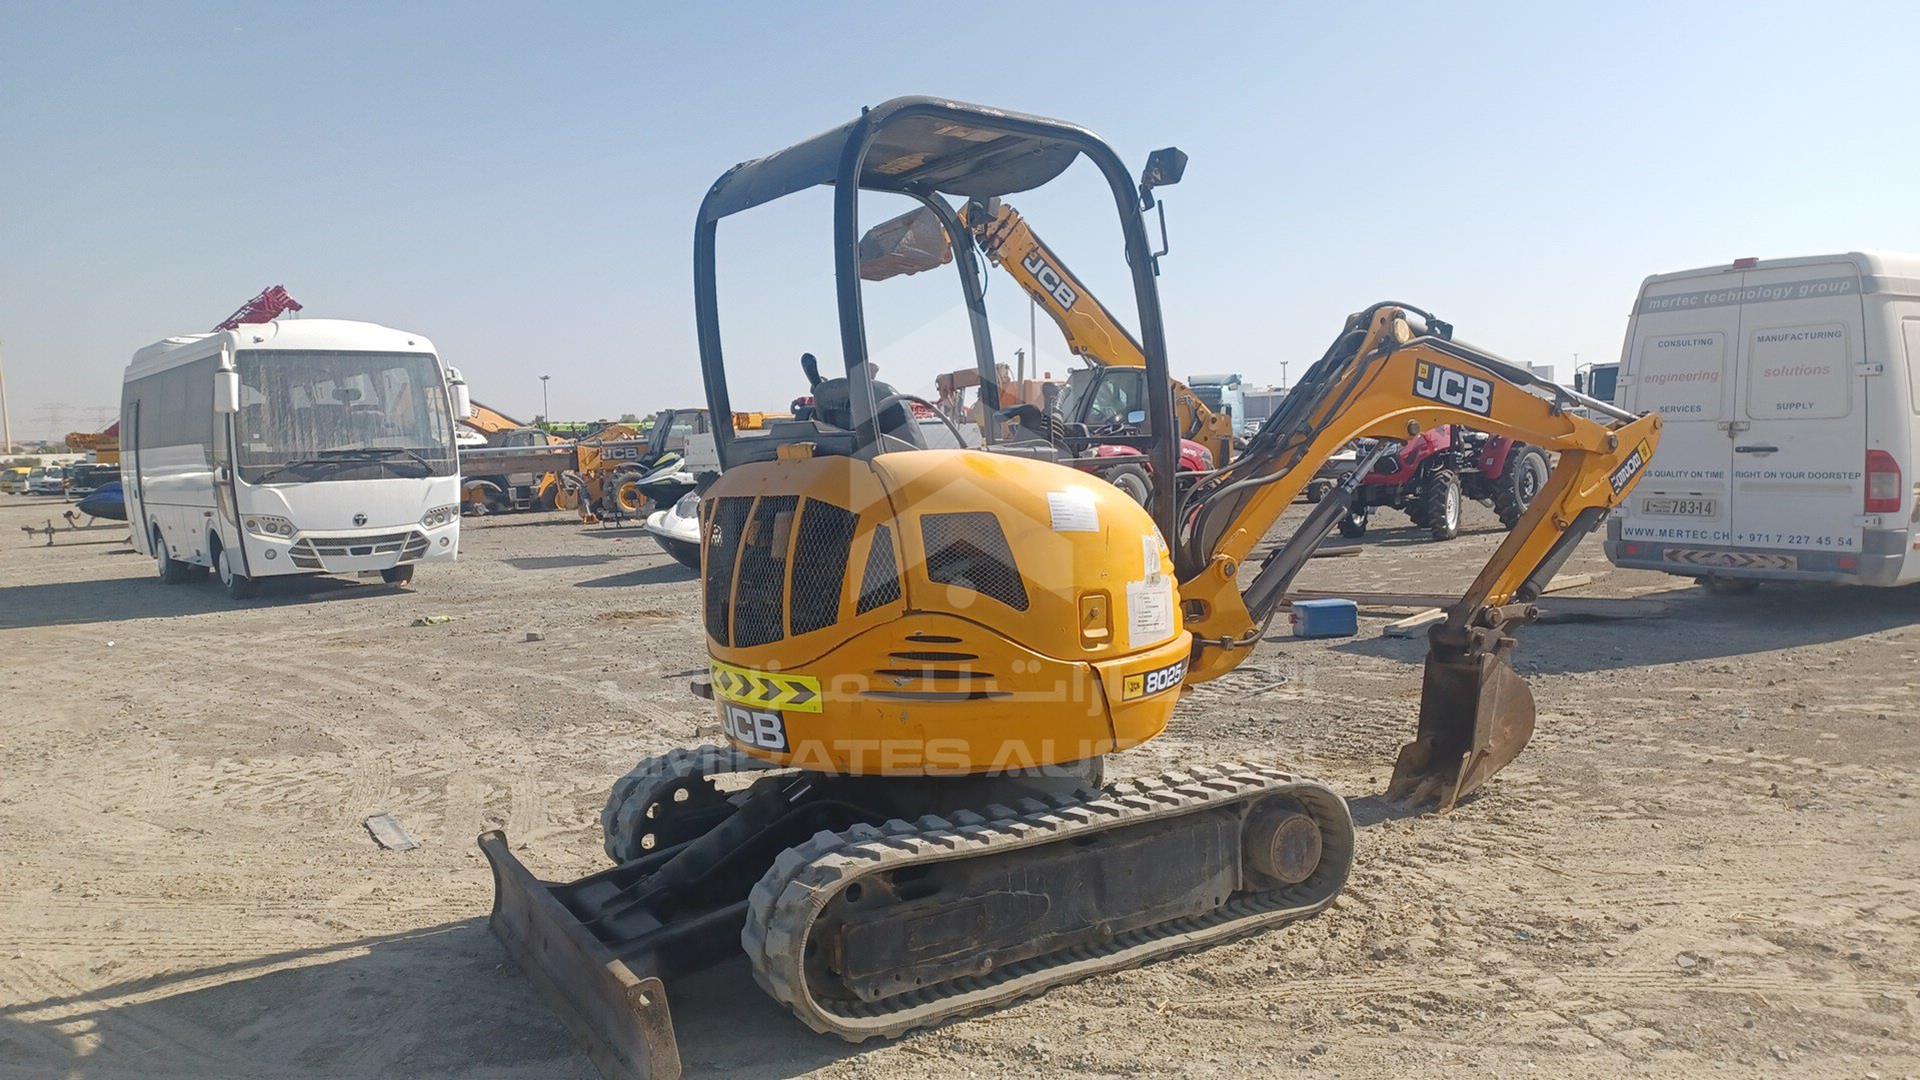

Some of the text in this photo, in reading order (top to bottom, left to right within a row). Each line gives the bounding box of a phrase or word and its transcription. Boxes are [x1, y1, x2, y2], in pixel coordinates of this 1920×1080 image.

[1023, 257, 1076, 309] JCB
[1649, 280, 1851, 309] mertec technology group
[1658, 338, 1714, 348] CONSULTING
[1757, 330, 1842, 343] MANUFACTURING
[1644, 369, 1719, 385] engineering
[1763, 364, 1831, 377] solutions
[1416, 366, 1490, 413] JCB
[1659, 405, 1701, 413] SERVICES
[1776, 402, 1814, 410] SUPPLY
[602, 448, 637, 459] JCB
[1654, 471, 1689, 479] QUALITY
[1690, 471, 1704, 479] ON
[1705, 471, 1724, 479] TIME
[1735, 471, 1761, 479] RIGHT
[1763, 471, 1777, 479] ON
[1780, 471, 1806, 480] YOUR
[1807, 471, 1861, 480] DOORSTEP
[1624, 527, 1730, 540] WWW.MERTEC.CH
[1749, 533, 1770, 542] 971
[1776, 534, 1782, 543] 7
[1788, 535, 1810, 544] 227
[1816, 536, 1831, 545] 45
[1837, 537, 1852, 546] 54
[1146, 663, 1182, 693] 8025
[722, 705, 785, 749] JCB
